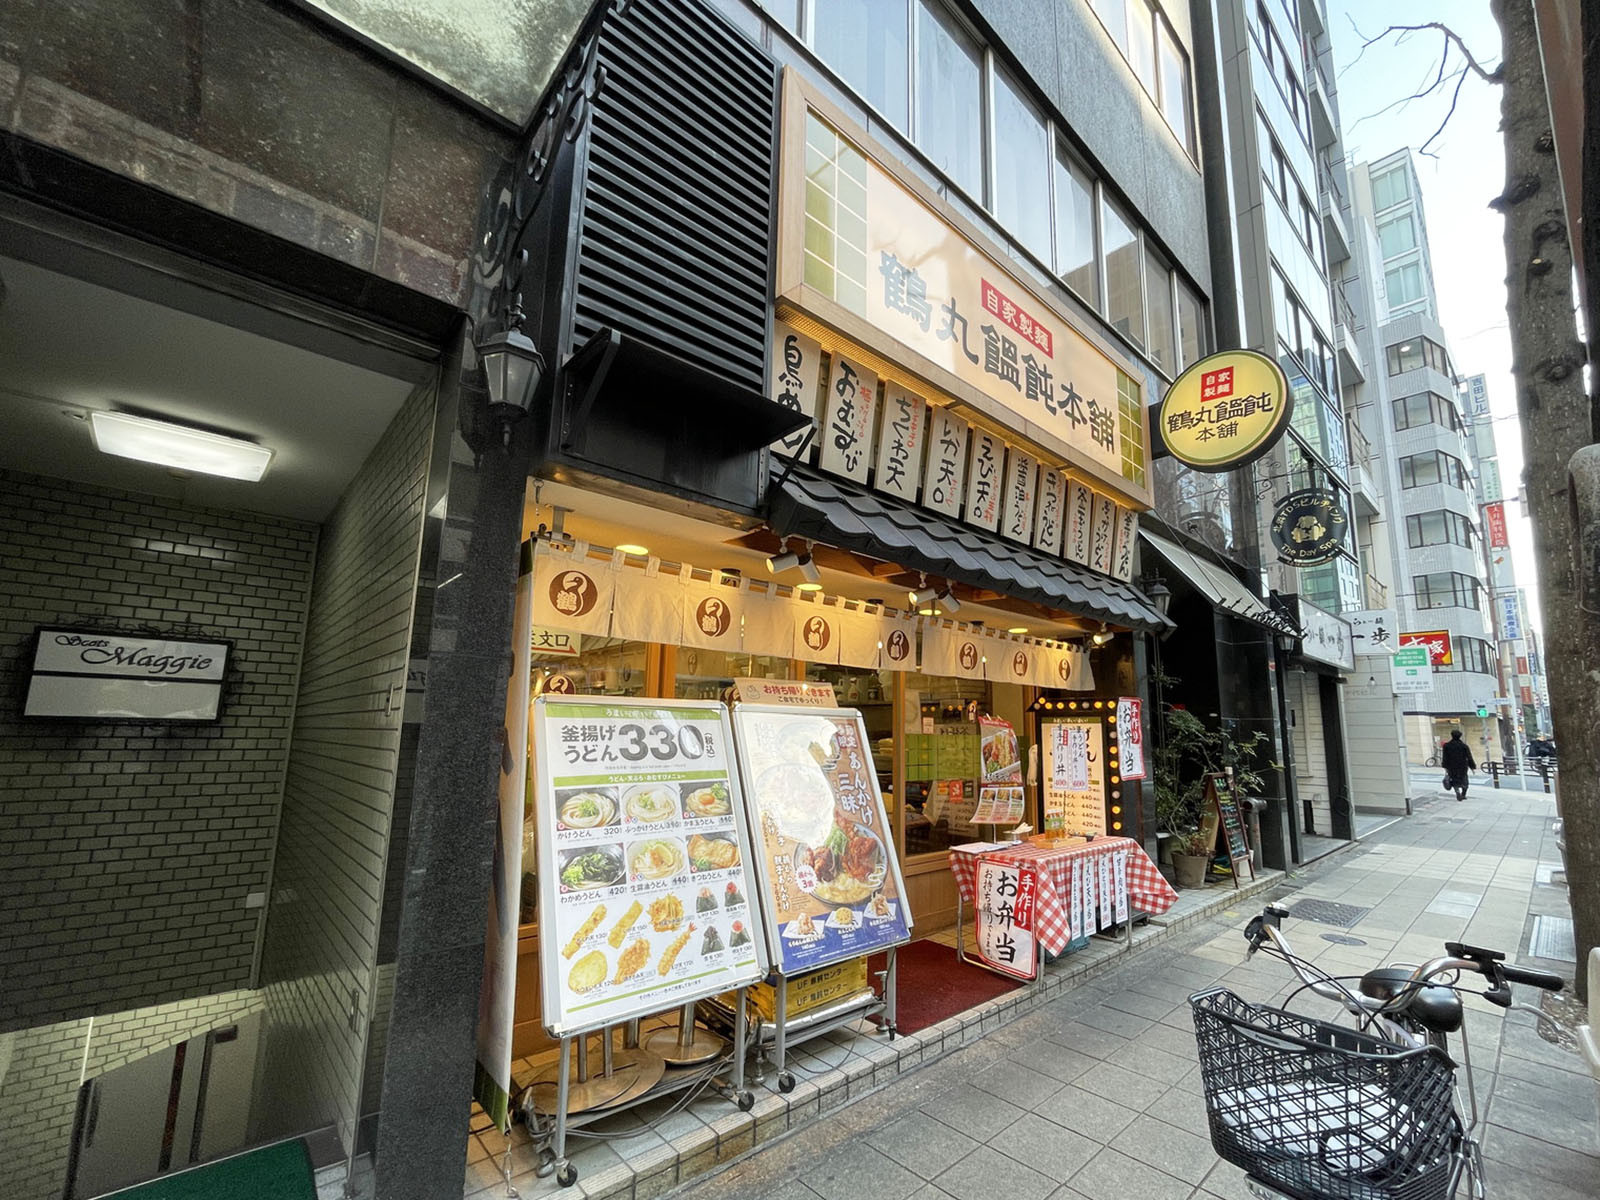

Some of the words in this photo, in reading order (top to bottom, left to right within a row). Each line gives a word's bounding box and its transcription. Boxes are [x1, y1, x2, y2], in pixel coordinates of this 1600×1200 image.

[878, 249, 1116, 455] 鶴丸饂飩本舗
[1167, 392, 1274, 434] 鶴丸饂飩
[886, 396, 912, 491] ちくわ天
[1195, 420, 1239, 443] 本舗
[1281, 544, 1296, 556] The
[1300, 549, 1316, 557] Day
[1320, 538, 1337, 551] Spa
[531, 630, 570, 647] 文口
[80, 647, 213, 674] Maggie
[763, 685, 831, 697] お持ち帰りきます
[561, 724, 616, 742] 釜揚げ
[618, 723, 704, 761] 330
[564, 744, 618, 764] うどん
[1123, 705, 1134, 773] お弁当
[848, 751, 873, 827] あんかけ
[557, 831, 592, 840] かけうどん
[560, 892, 601, 904] わかめうどん
[1017, 874, 1034, 927] 手作り
[996, 871, 1018, 963] お弁当
